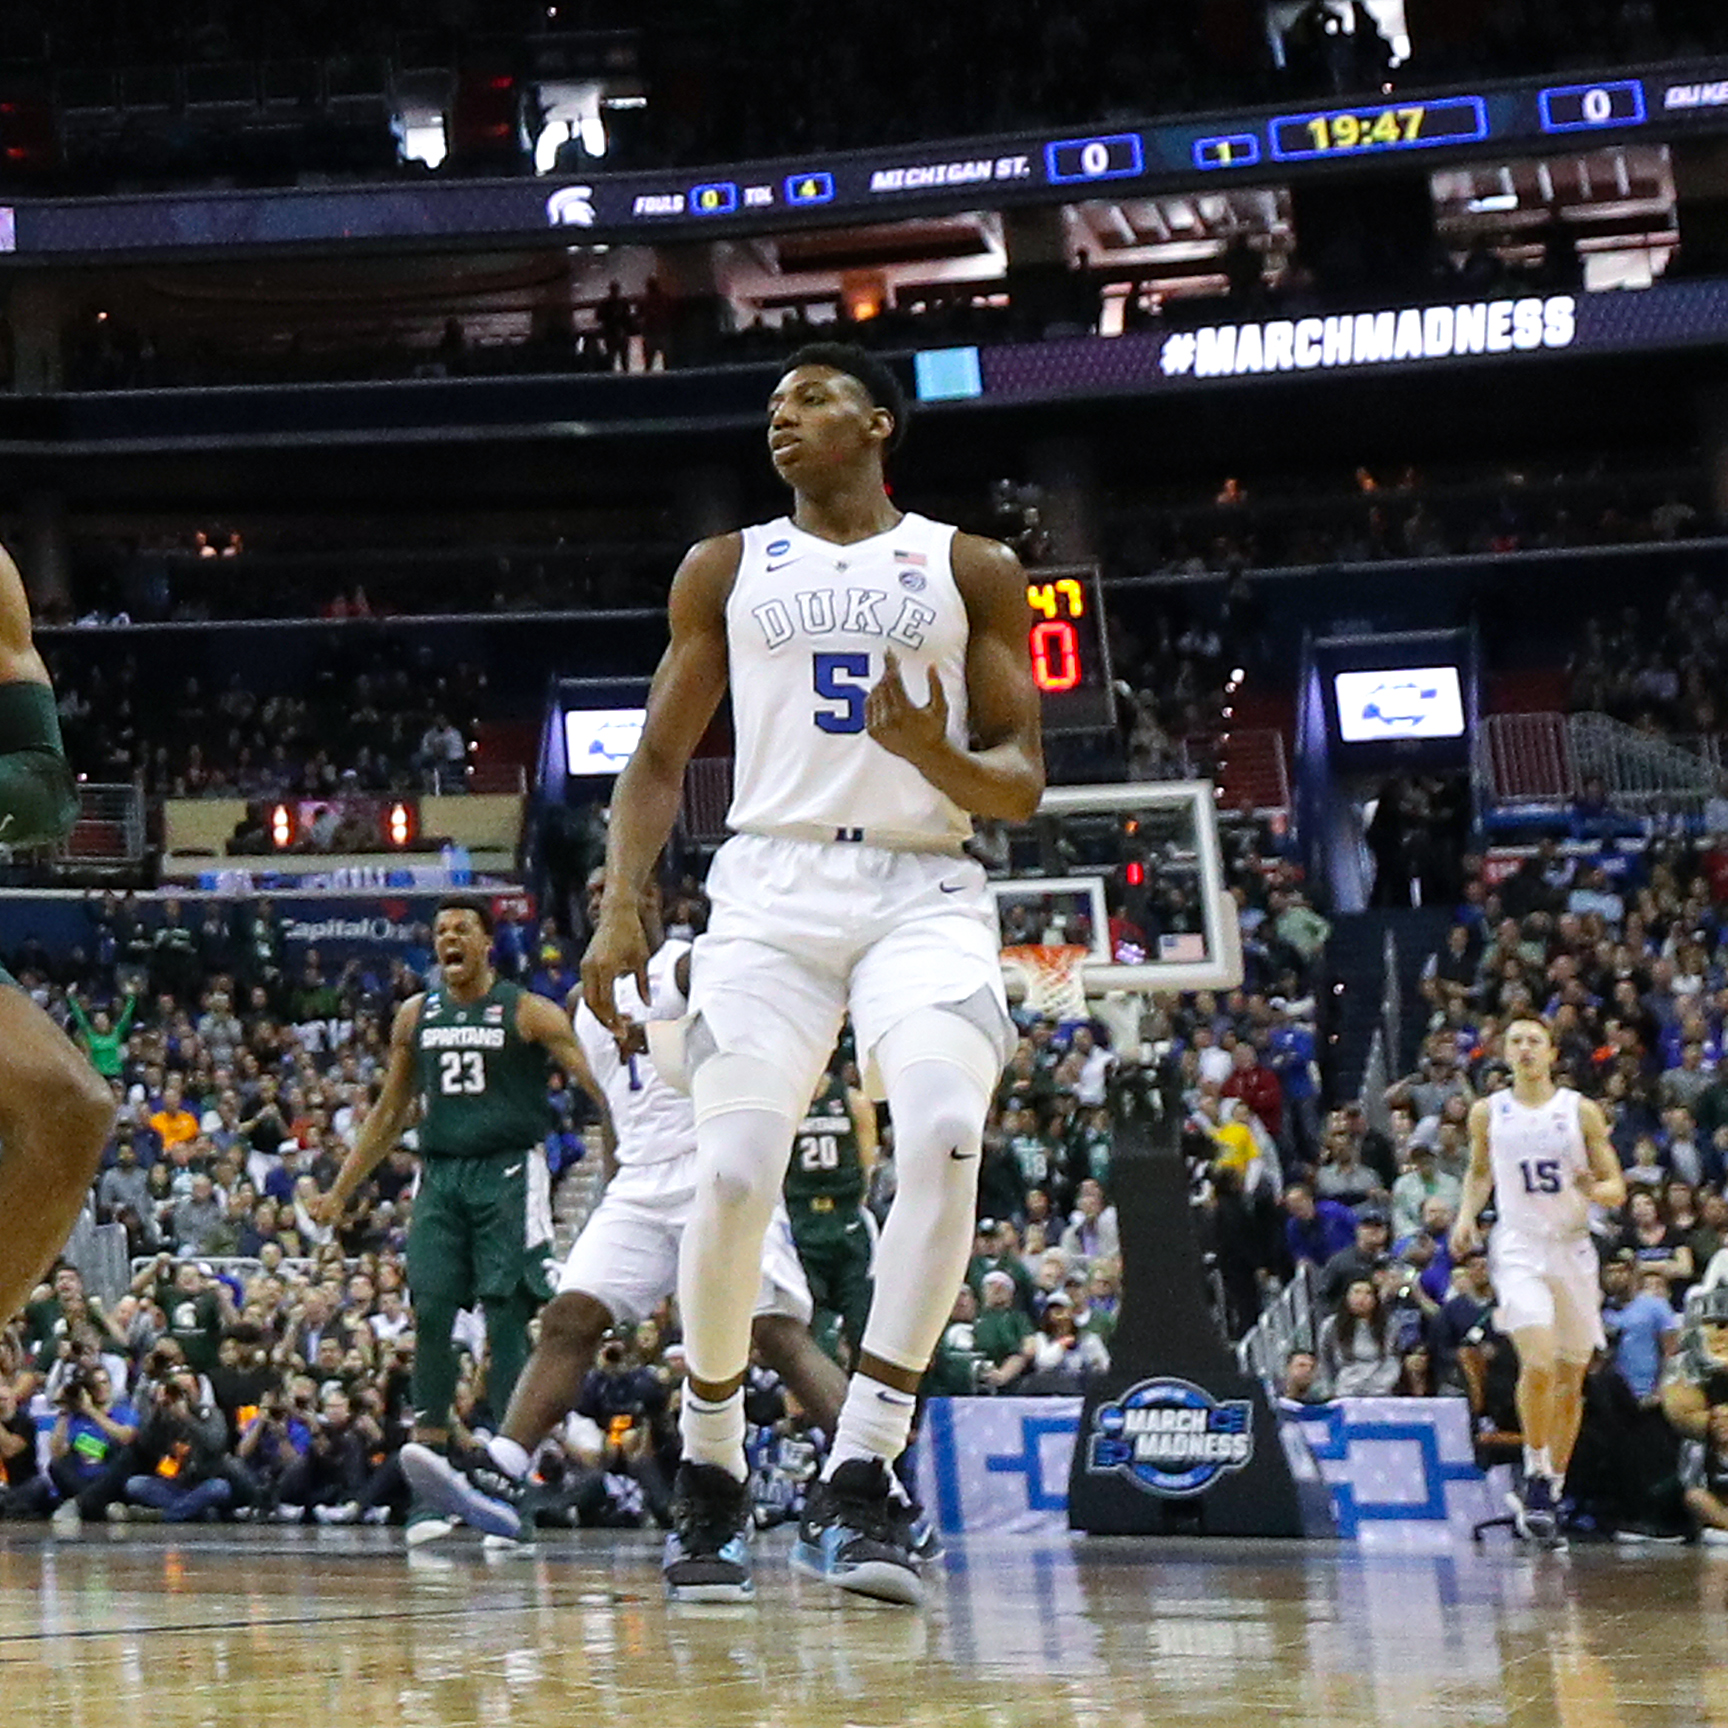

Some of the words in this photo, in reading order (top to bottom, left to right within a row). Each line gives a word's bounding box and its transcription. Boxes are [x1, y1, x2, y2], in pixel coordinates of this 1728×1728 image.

[1080, 142, 1109, 175] 0
[1307, 107, 1426, 151] 19:47
[1582, 88, 1612, 123] 0
[870, 159, 993, 193] MICHIGAN
[994, 156, 1032, 181] ST.
[1160, 295, 1576, 378] #MARCHMADNESS
[752, 586, 937, 651] DUKE
[813, 652, 871, 734] 5
[420, 1025, 506, 1050] SPARTANS
[439, 1050, 487, 1096] 23
[799, 1135, 839, 1171] 20
[1519, 1159, 1562, 1194] 15
[1123, 1408, 1209, 1435] MARCH
[1134, 1432, 1252, 1463] MADNESS
